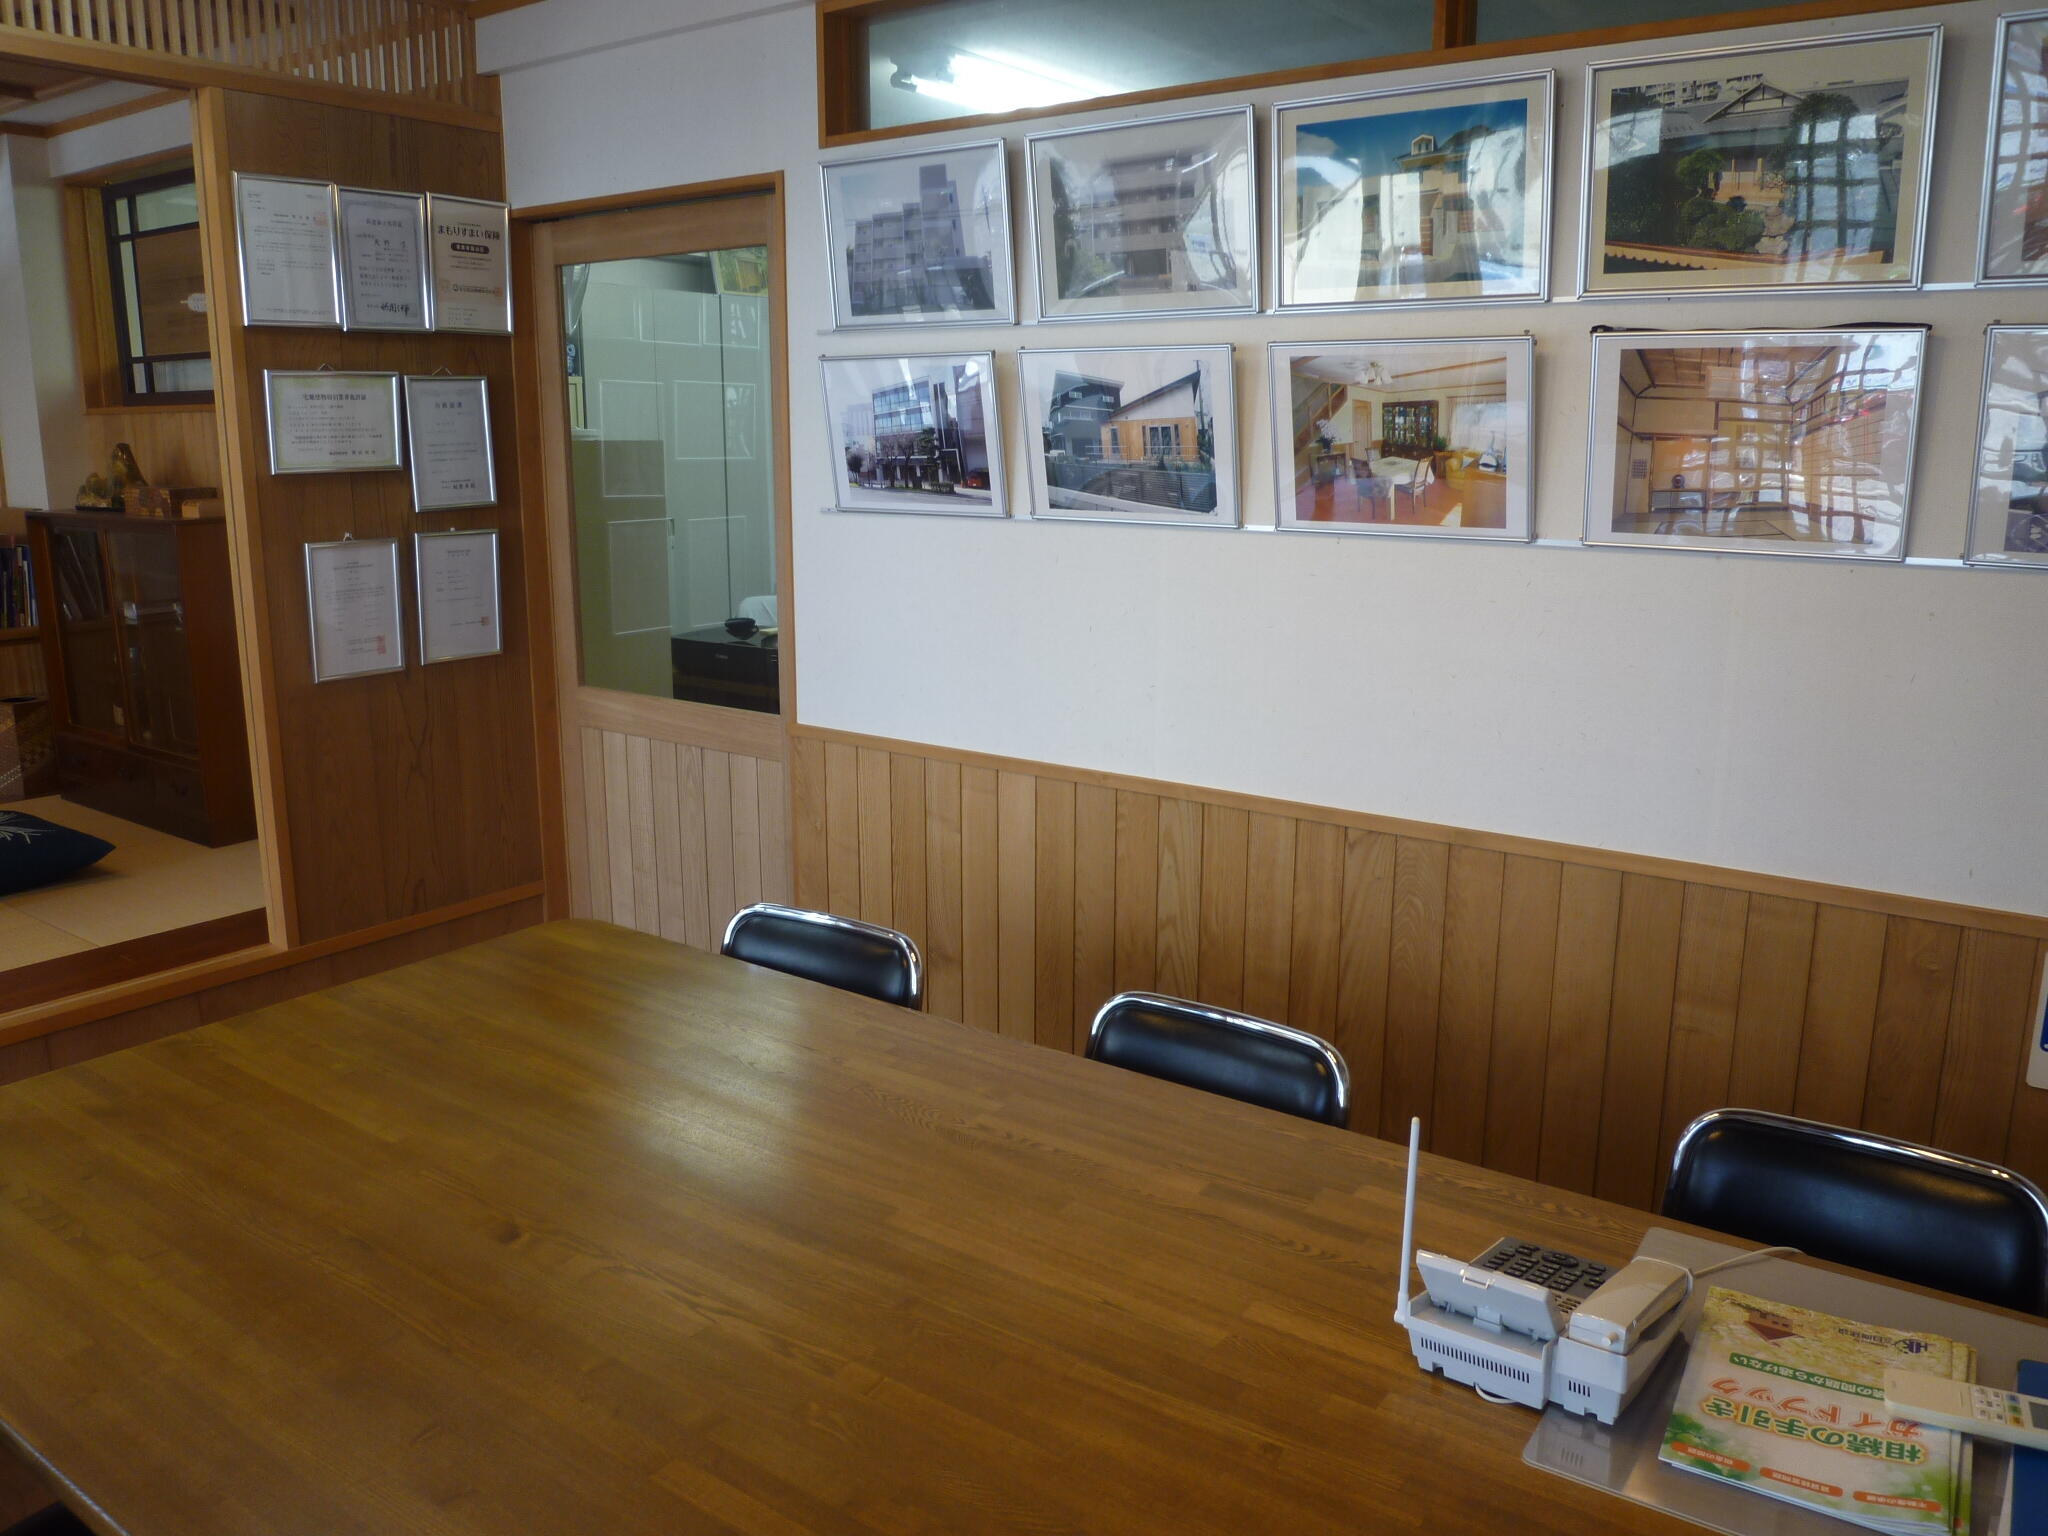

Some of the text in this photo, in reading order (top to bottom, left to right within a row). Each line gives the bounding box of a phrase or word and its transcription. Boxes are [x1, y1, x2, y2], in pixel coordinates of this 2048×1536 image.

[1705, 1398, 1921, 1462] 相続の手引き
[1711, 1379, 1920, 1437] ガイドブック
